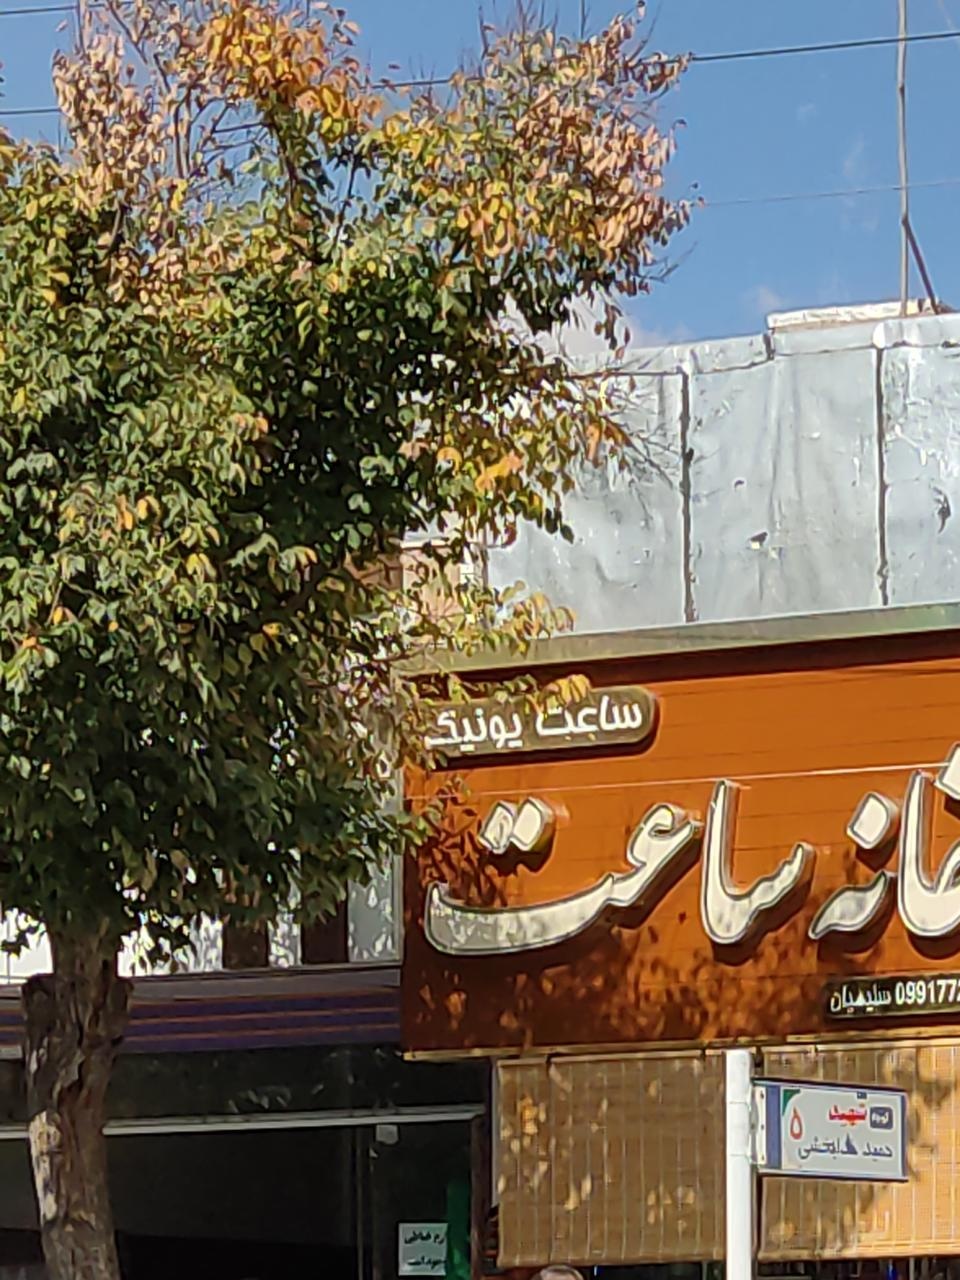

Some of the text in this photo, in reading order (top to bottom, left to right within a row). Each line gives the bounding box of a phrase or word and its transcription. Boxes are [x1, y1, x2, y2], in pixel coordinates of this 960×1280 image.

[535, 695, 643, 738] ساعت
[425, 778, 814, 956] ساعت
[828, 1103, 868, 1127] شهید
[861, 1141, 893, 1162] حمید
